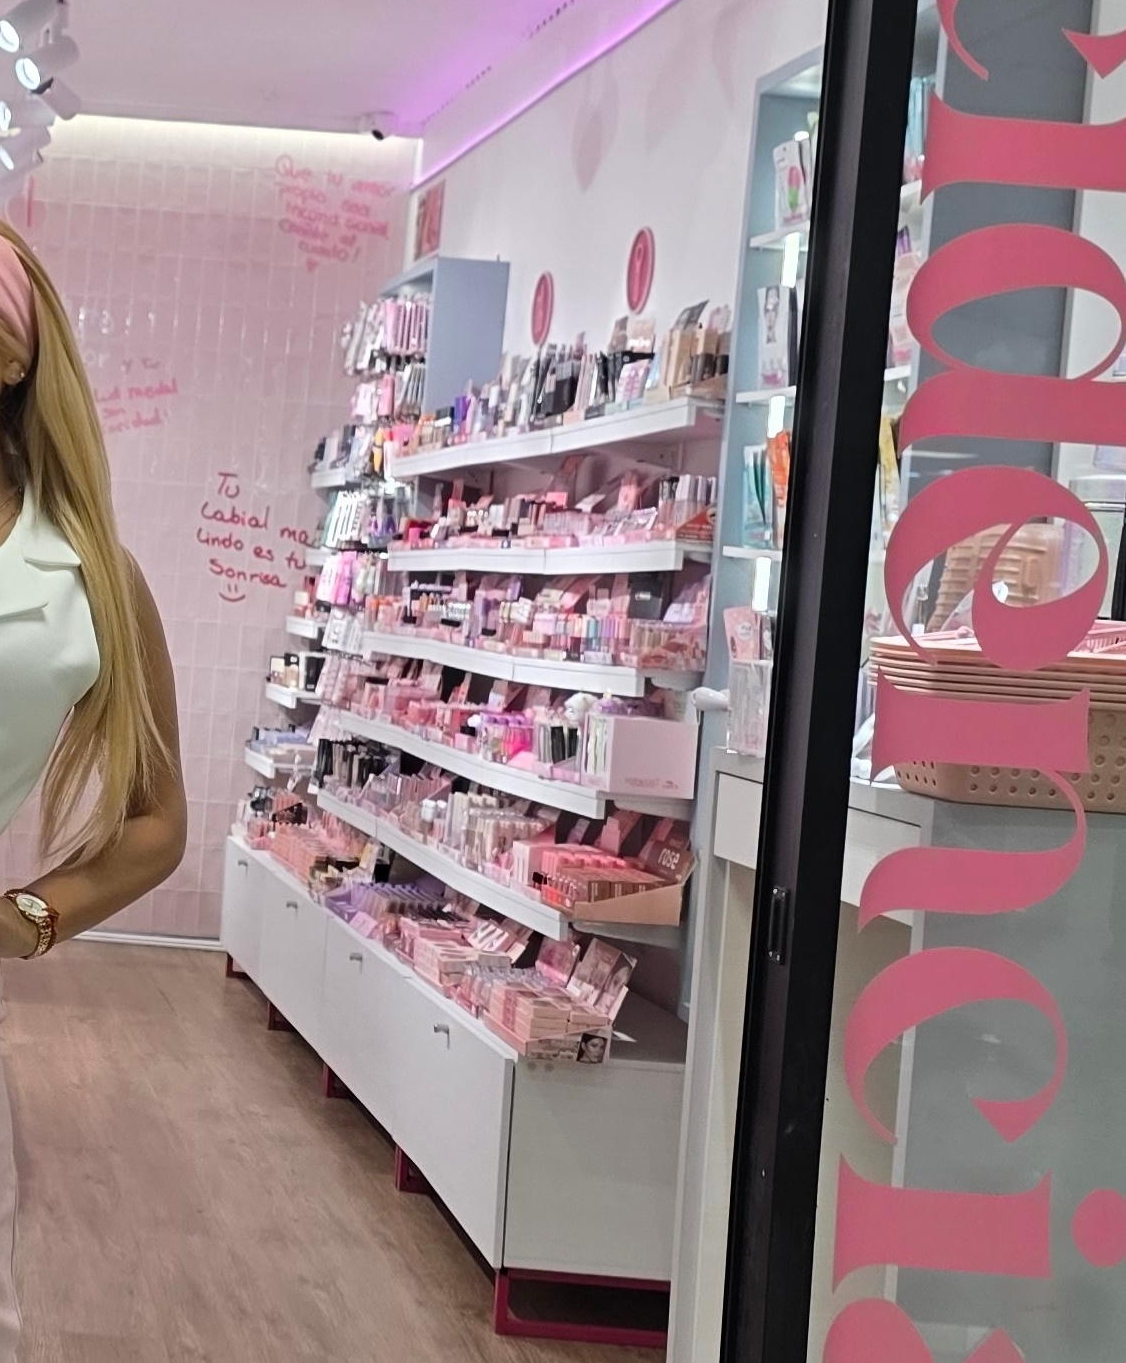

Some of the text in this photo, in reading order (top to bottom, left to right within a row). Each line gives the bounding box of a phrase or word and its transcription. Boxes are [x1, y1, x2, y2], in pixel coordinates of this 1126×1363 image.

[218, 472, 240, 499] Tu
[253, 545, 275, 561] es
[285, 551, 307, 570] tu
